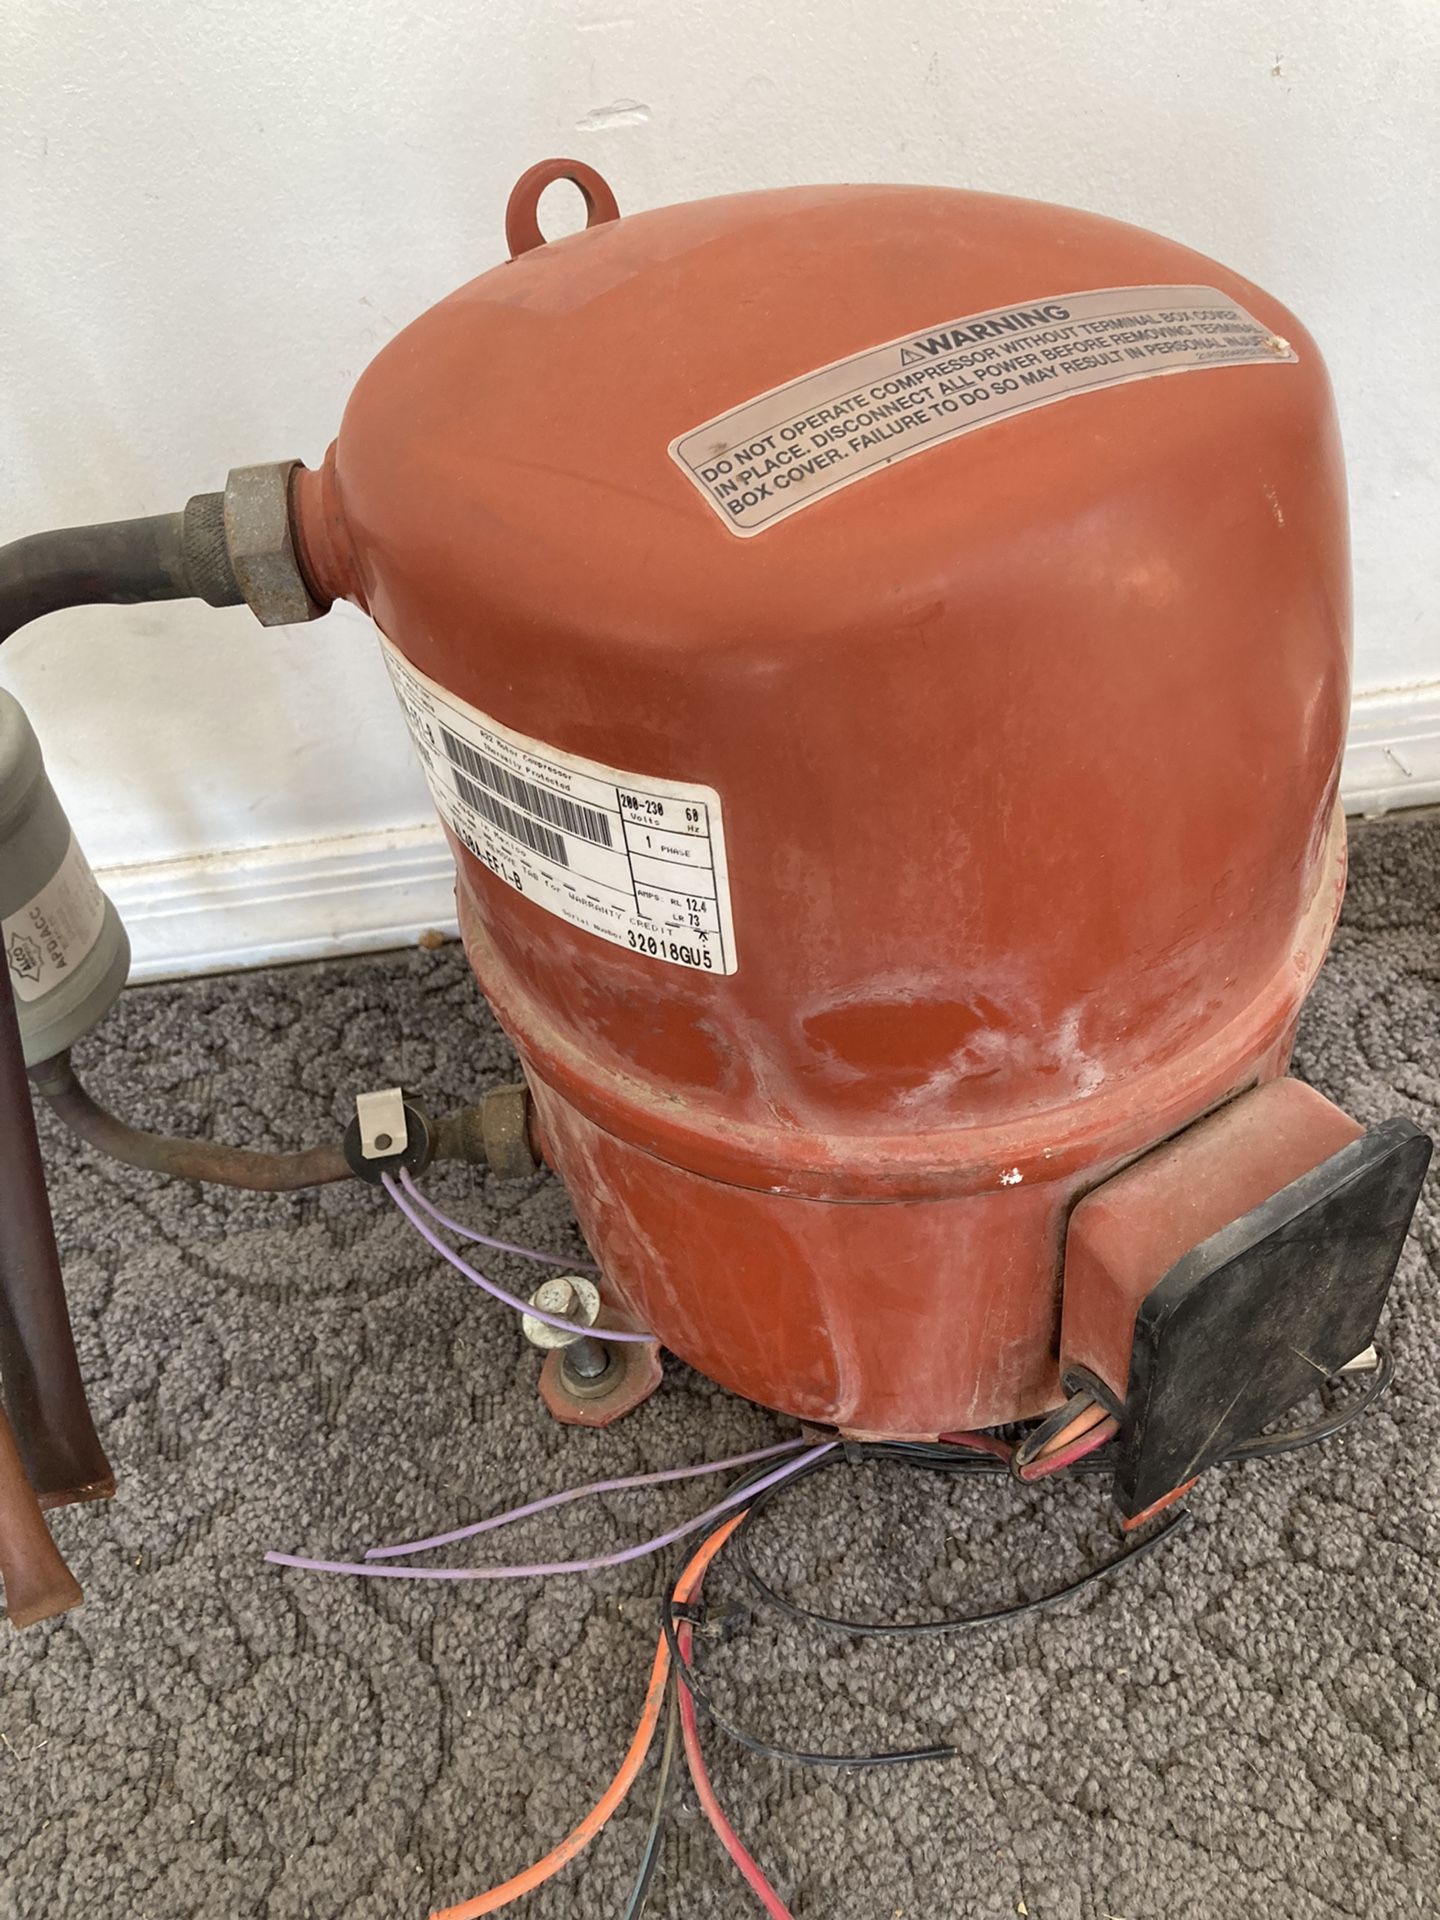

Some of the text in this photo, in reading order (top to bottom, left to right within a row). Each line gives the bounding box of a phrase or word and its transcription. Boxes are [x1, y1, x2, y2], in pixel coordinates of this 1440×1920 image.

[914, 305, 1070, 355] WARNING
[701, 309, 1239, 482] DO NOT OPERATE COMPRESSOR WITHOUT TERMINAL BOX COVER
[714, 324, 1264, 498] IN PLACE. DISCONNECT ALL POWER BEFORE REMOVING TERMINAL
[727, 483, 773, 515] BOX
[773, 448, 849, 489] COVER.
[848, 410, 931, 452] FAILURE
[928, 399, 959, 417] TO
[959, 388, 990, 406] DO
[990, 378, 1019, 395] SO
[1019, 366, 1059, 386] MAY
[1059, 350, 1126, 374] RESULT
[1125, 347, 1146, 358] IN
[1148, 338, 1227, 355] PERSONAL
[522, 754, 572, 780] Compressor
[525, 766, 571, 791] Protected
[620, 794, 699, 823] 200-230 60
[630, 813, 700, 833] Volts Hz
[646, 835, 691, 857] 1 PHASE
[568, 892, 621, 920] WARRANTY
[629, 918, 672, 936] CREDIT
[670, 898, 682, 907] RL
[686, 898, 707, 912] 12.4
[673, 913, 700, 926] LR 73
[627, 929, 712, 969] 32018GU5
